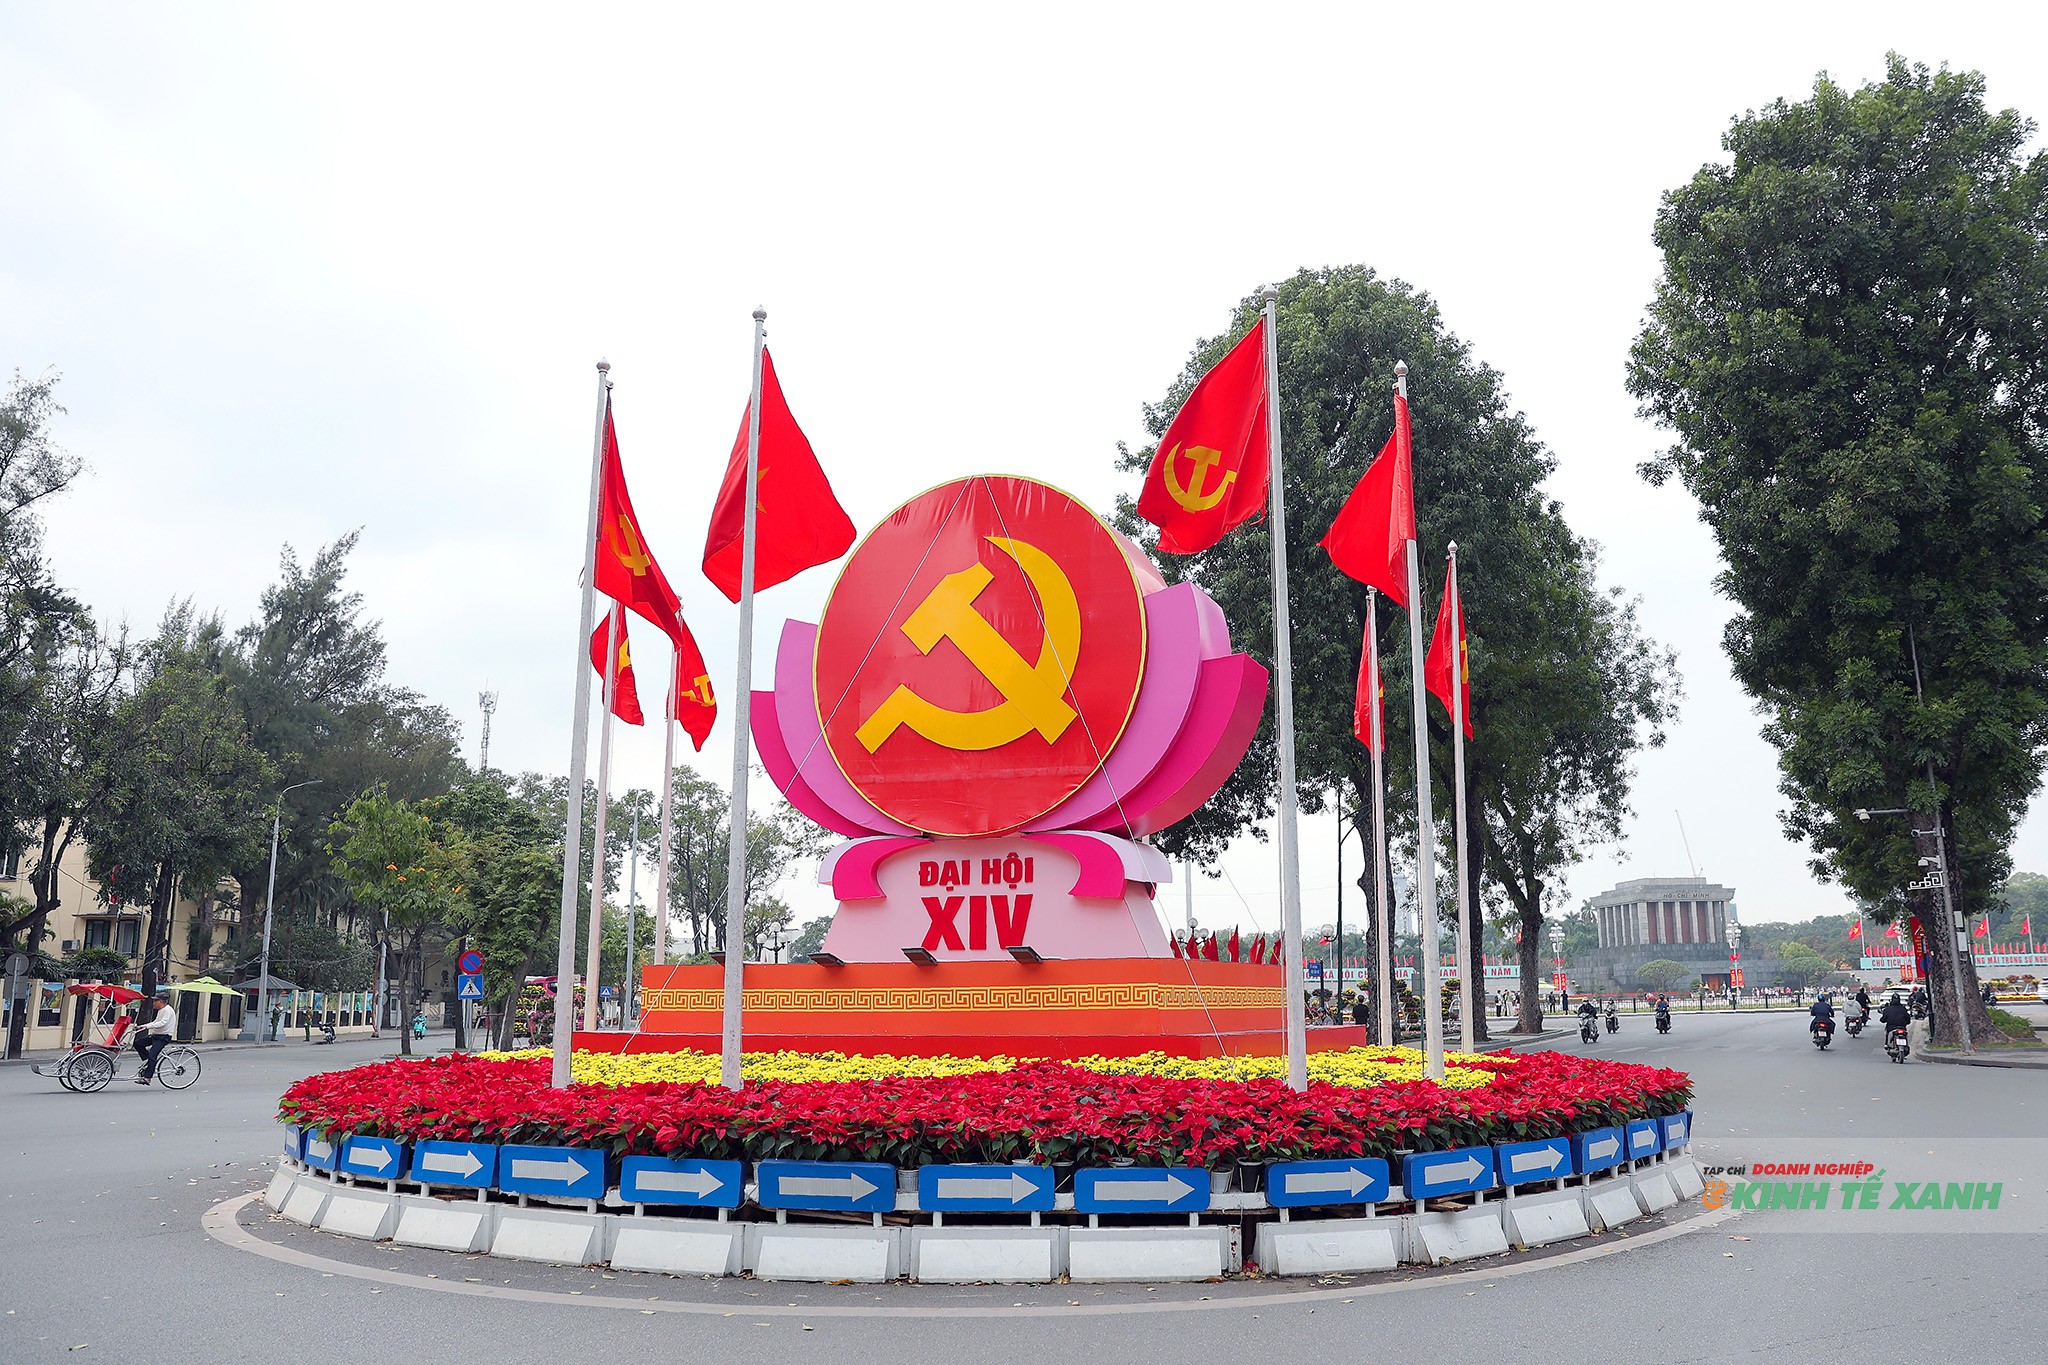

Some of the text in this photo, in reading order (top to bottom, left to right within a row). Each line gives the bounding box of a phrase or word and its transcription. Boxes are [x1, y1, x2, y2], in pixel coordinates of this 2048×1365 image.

[919, 852, 1034, 892] ĐẠI HỘI
[921, 894, 1034, 951] XIV
